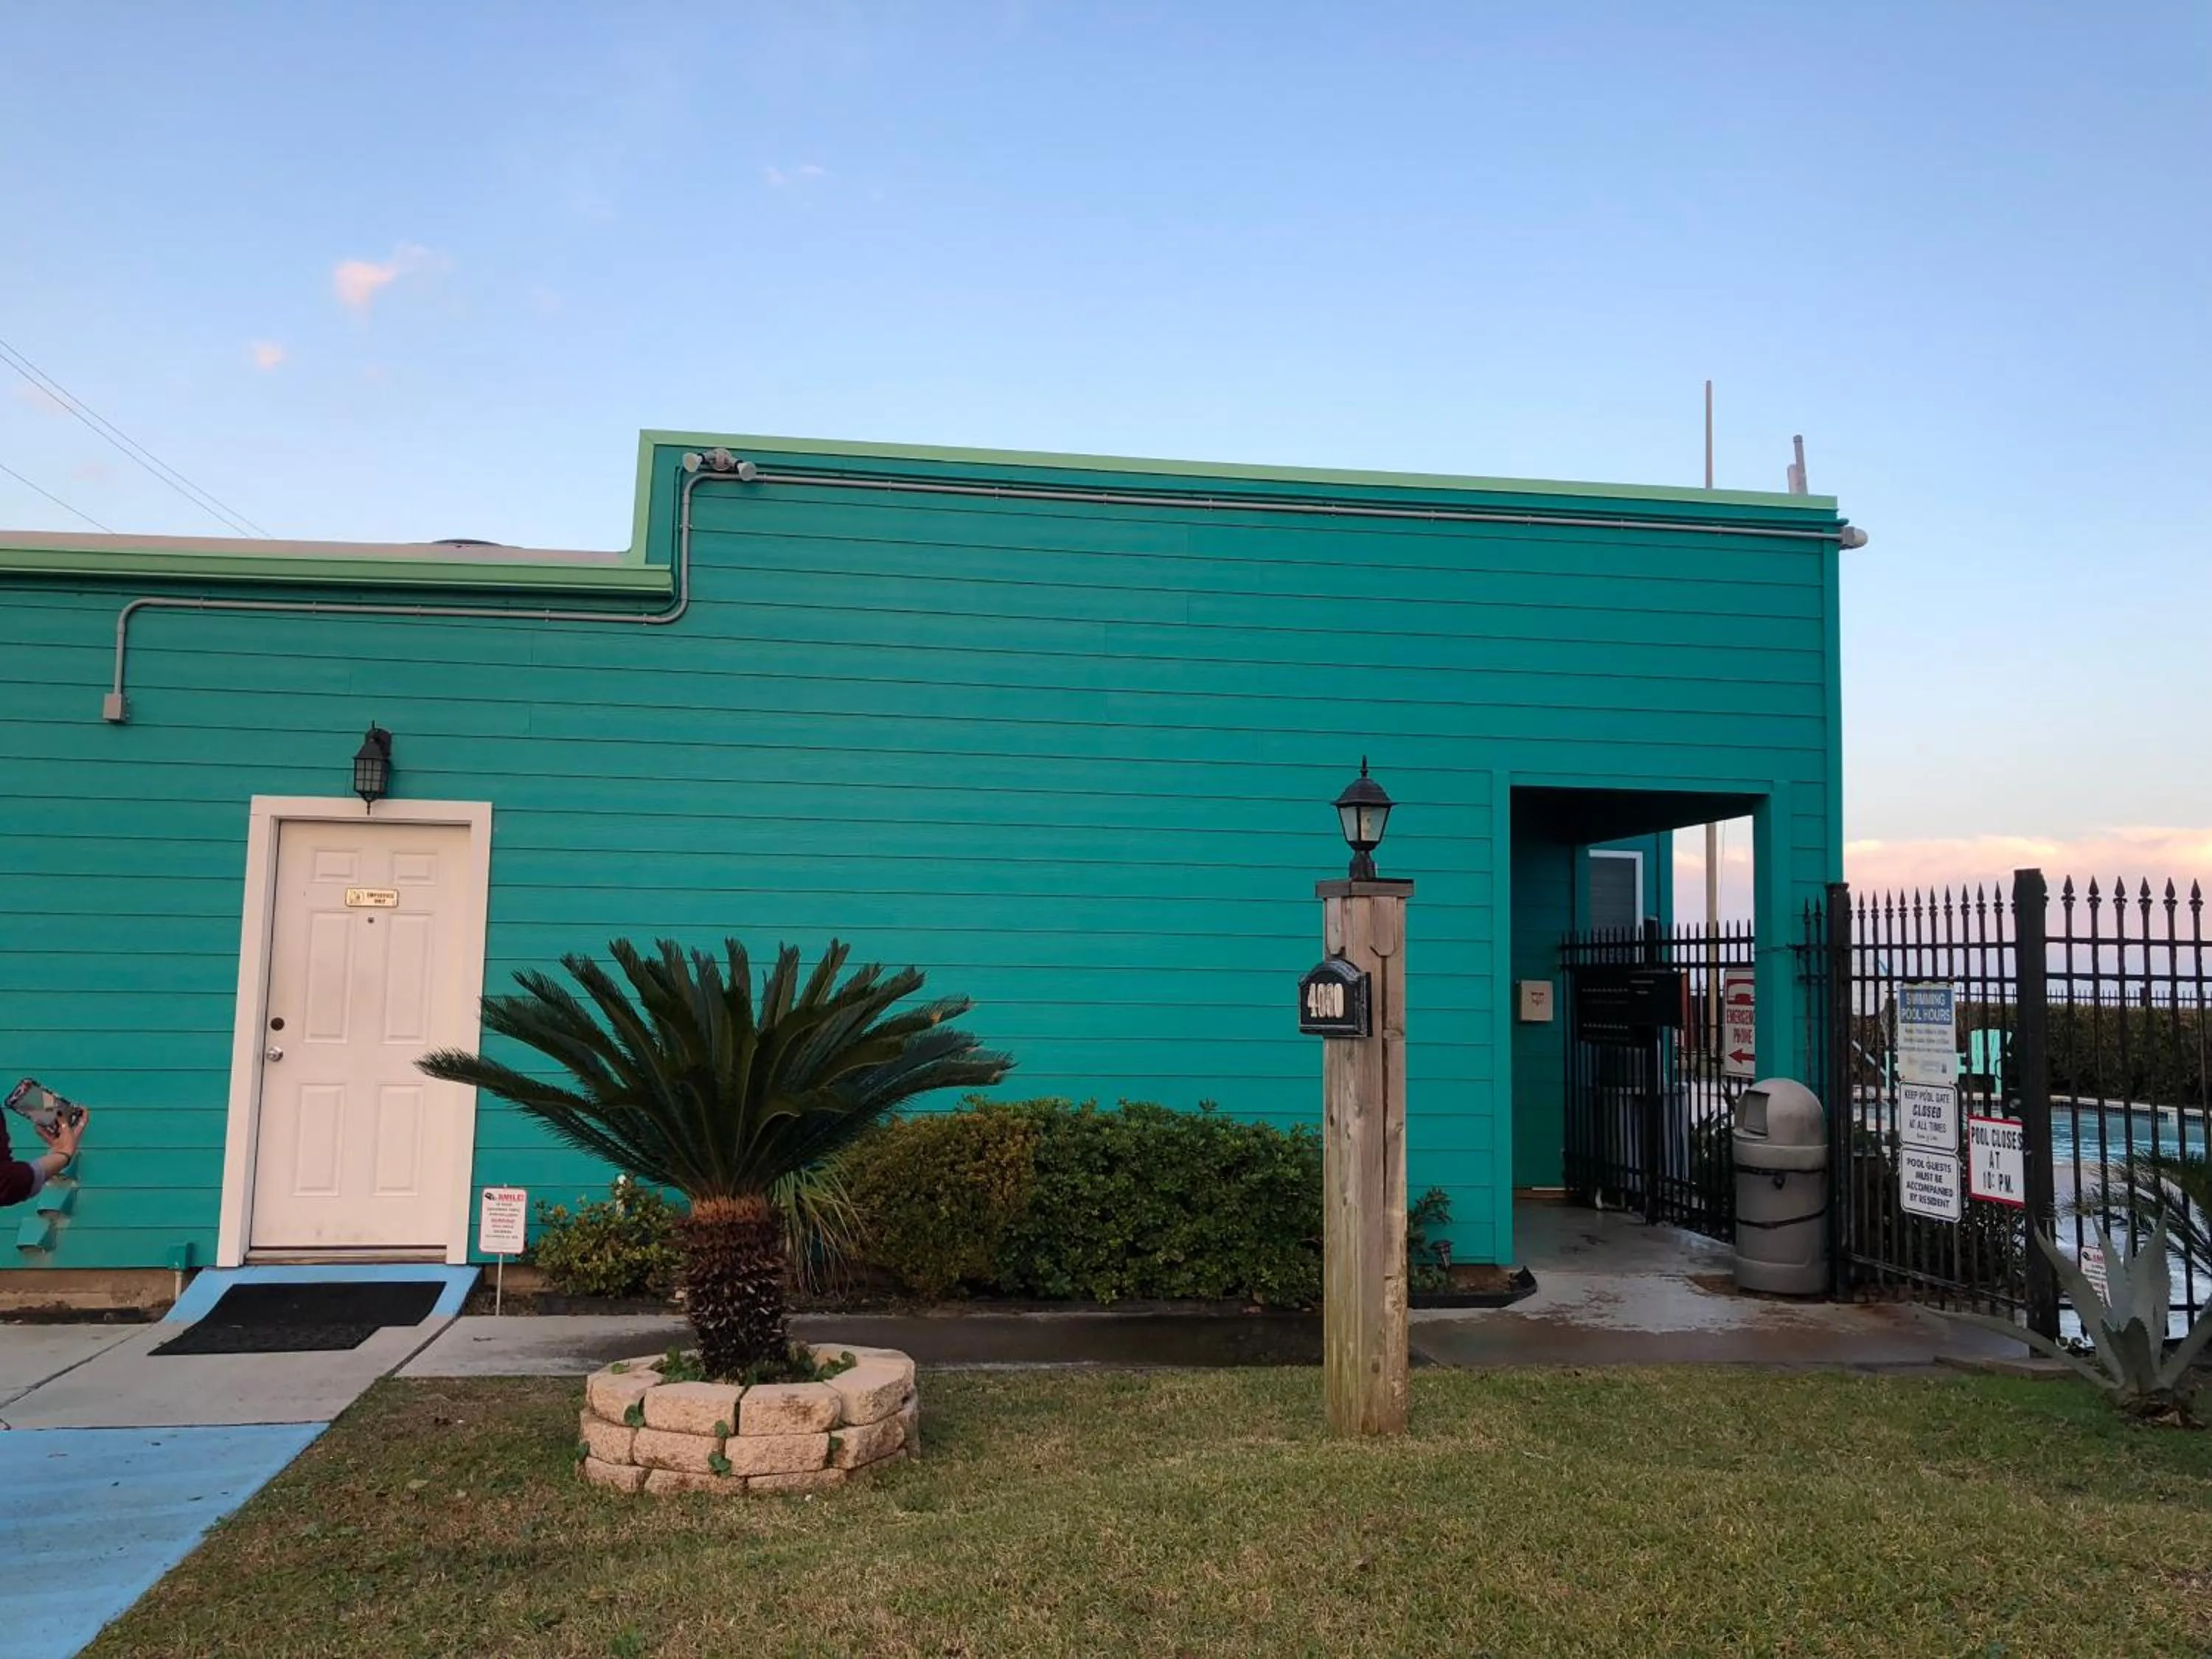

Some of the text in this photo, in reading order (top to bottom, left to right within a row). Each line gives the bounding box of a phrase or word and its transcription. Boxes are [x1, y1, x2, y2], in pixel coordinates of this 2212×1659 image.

[1727, 1009, 1754, 1025] EMERGEN
[1901, 1007, 1951, 1022] POOL HOURS
[1733, 1029, 1753, 1044] PHONE
[1905, 1091, 1950, 1104] KEEP POOL GATE
[1913, 1104, 1941, 1119] CLOSED
[1929, 1121, 1947, 1133] TIMES
[1971, 1126, 2024, 1151] POOL CLOSES
[1906, 1157, 1952, 1173] POOL GUESTS
[1989, 1150, 2000, 1169] AT
[1915, 1171, 1943, 1183] MUST BE
[1906, 1181, 1953, 1197] ACCOMPANIED
[1910, 1192, 1950, 1208] BY RESIDENT
